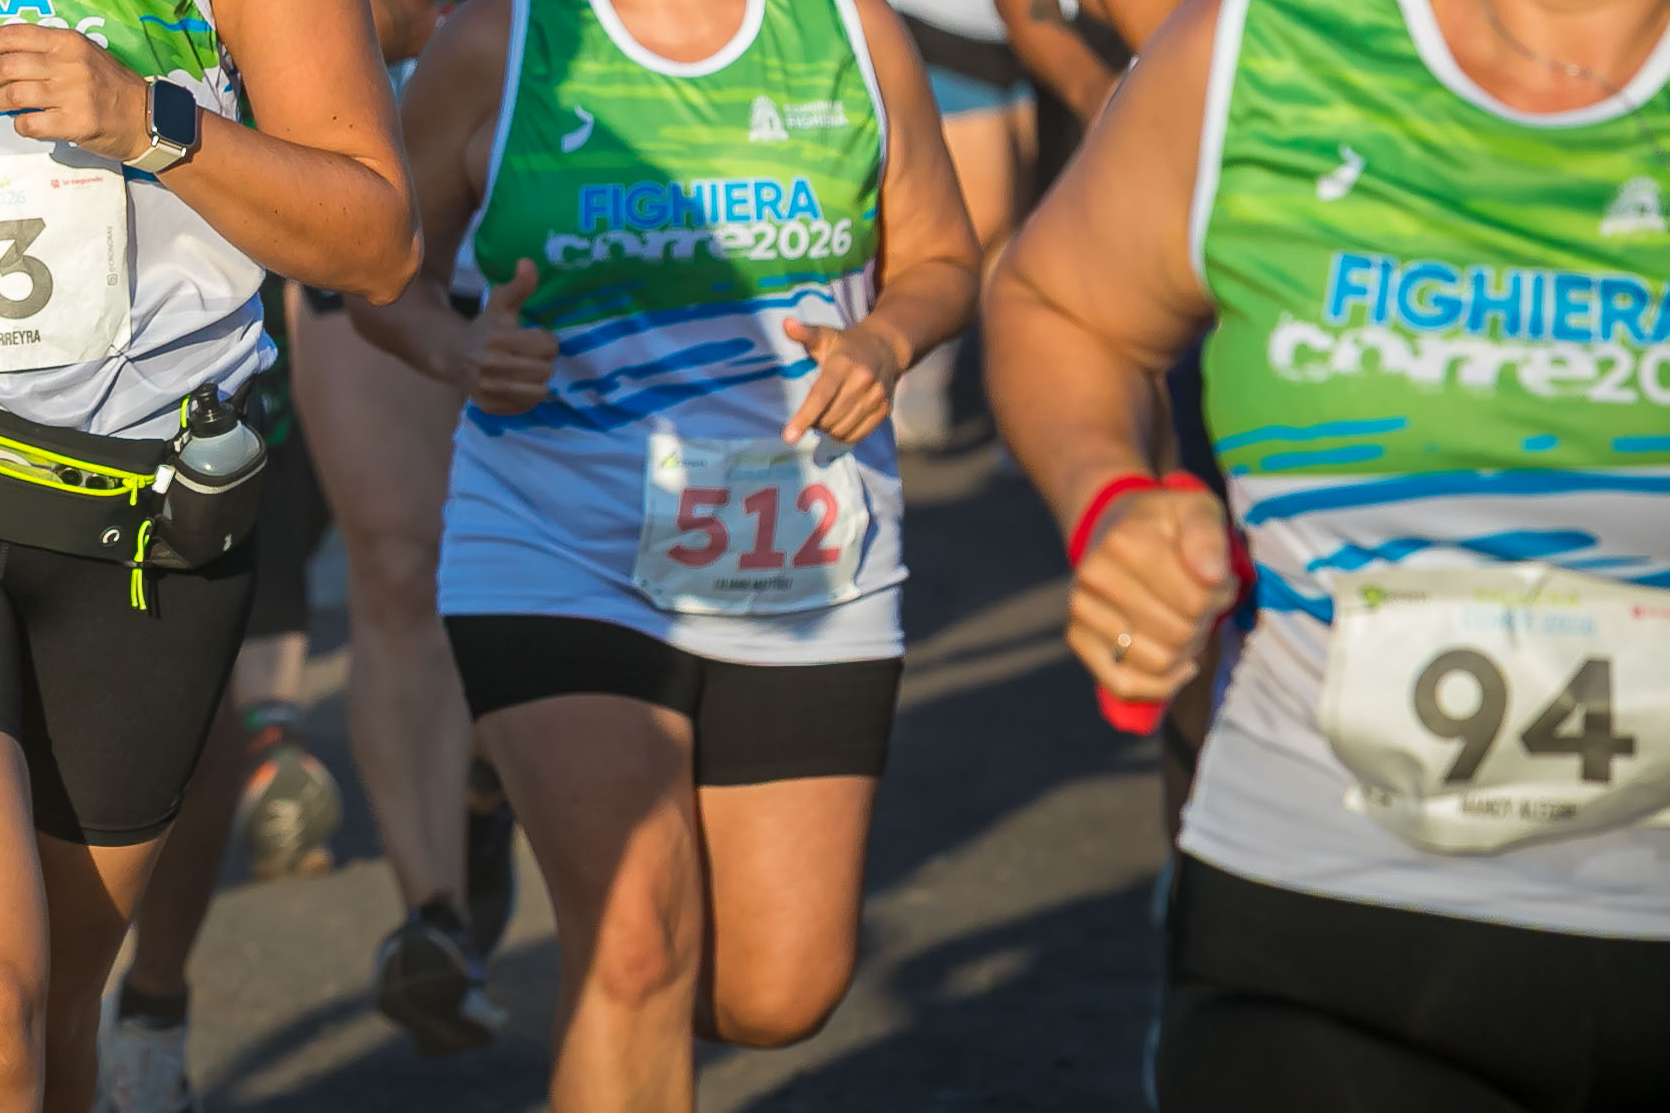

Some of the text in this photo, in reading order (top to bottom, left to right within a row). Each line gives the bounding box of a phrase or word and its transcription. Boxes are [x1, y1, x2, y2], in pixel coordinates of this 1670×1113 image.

[544, 219, 852, 268] corre2026
[577, 176, 822, 232] FIGHIERA
[1326, 250, 1670, 344] FIGHIER
[666, 481, 843, 571] 512
[1413, 646, 1637, 784] 94
